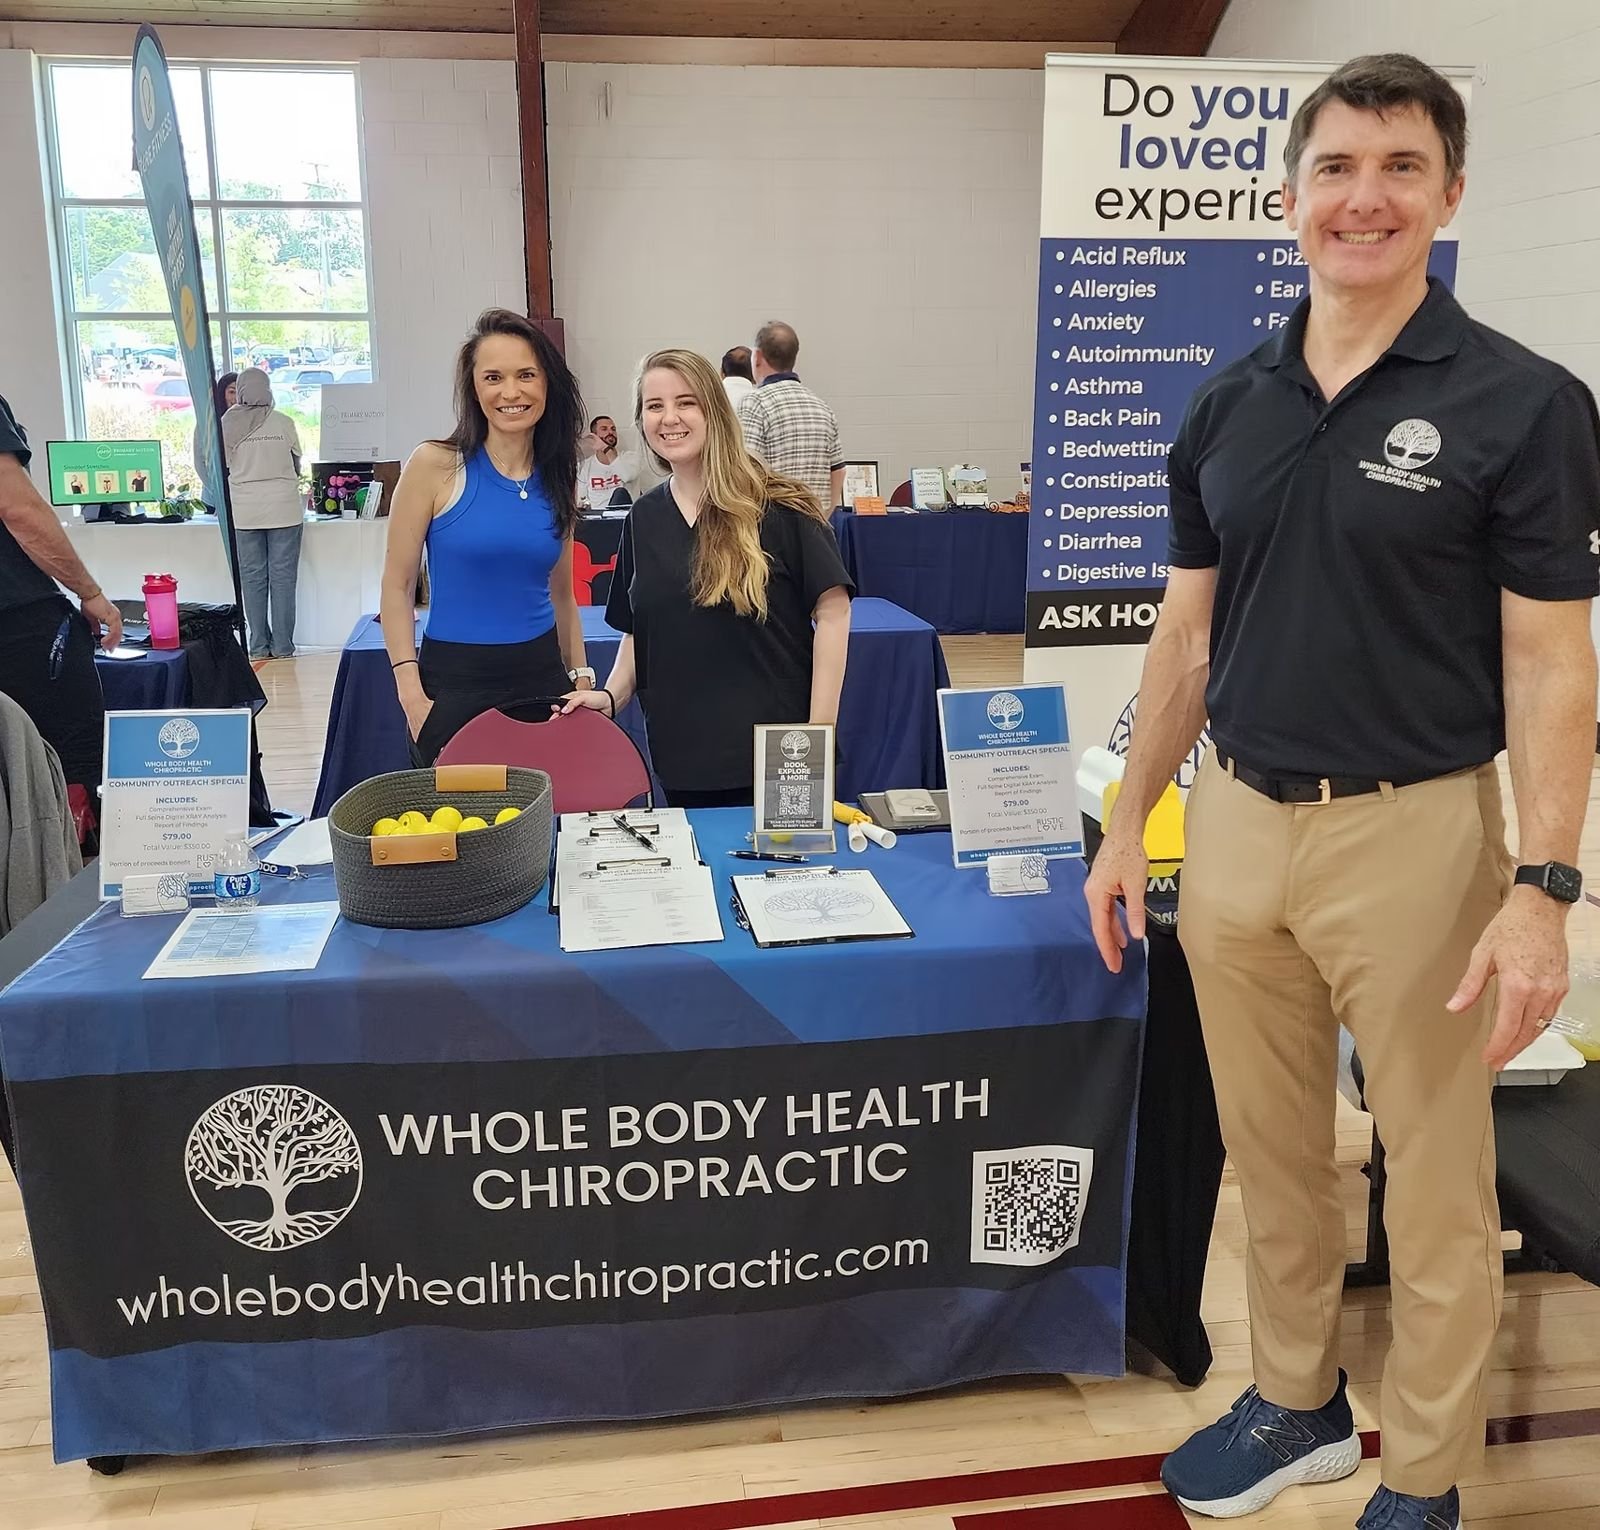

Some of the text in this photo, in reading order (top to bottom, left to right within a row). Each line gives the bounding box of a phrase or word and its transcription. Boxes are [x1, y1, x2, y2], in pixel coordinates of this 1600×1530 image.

[1103, 73, 1289, 130] Do you
[1119, 124, 1267, 171] loved
[1095, 177, 1285, 232] experie
[1070, 246, 1186, 266] Acid Reflux
[1272, 247, 1309, 266] Diz
[1069, 279, 1157, 301] Allergies
[1270, 280, 1304, 298] Ear
[1067, 312, 1144, 334] Anxiety
[1268, 312, 1290, 330] Fa
[1066, 344, 1215, 367] Autoimmunity
[1064, 377, 1143, 396] Asthma
[1064, 408, 1162, 427] Back Pain
[1060, 470, 1170, 490] Constipatio
[1359, 460, 1442, 488] WHOLE BODY HEALTH
[1366, 472, 1426, 491] CHIROPRACTIC
[1060, 501, 1169, 522] Depression
[1058, 532, 1142, 551] Diarrhea
[1057, 562, 1173, 583] Digestive Iss
[1038, 603, 1161, 629] ASK HO
[978, 730, 1038, 741] WHOLE BODY HEALTH
[986, 736, 1030, 745] CHIROPRACTIC
[949, 746, 1070, 761] COMMUNITY OUTREACH SPECIAL
[153, 766, 202, 774] CHIROPRACTIC
[168, 760, 187, 768] BODY
[778, 767, 811, 775] EXPLORE
[993, 765, 1030, 774] INCLUDES:
[109, 778, 246, 788] COMMUNITY OUTREACH SPECIAL
[155, 796, 198, 804] INCLUDES:
[1003, 799, 1029, 808] $79.00
[148, 814, 165, 822] Spine
[165, 813, 185, 821] Digital
[182, 821, 208, 829] Findings
[1036, 817, 1064, 826] RUSTIC
[162, 833, 192, 841] $79.00
[183, 842, 211, 850] $350.00
[140, 860, 168, 868] proceeds
[228, 875, 248, 884] Pure
[231, 881, 247, 892] Life
[379, 1078, 990, 1156] WHOLE BODY HEALTH
[473, 1142, 908, 1212] CHIROPRACTIC
[117, 1238, 929, 1327] wholebodyhealthchiropractic.com
